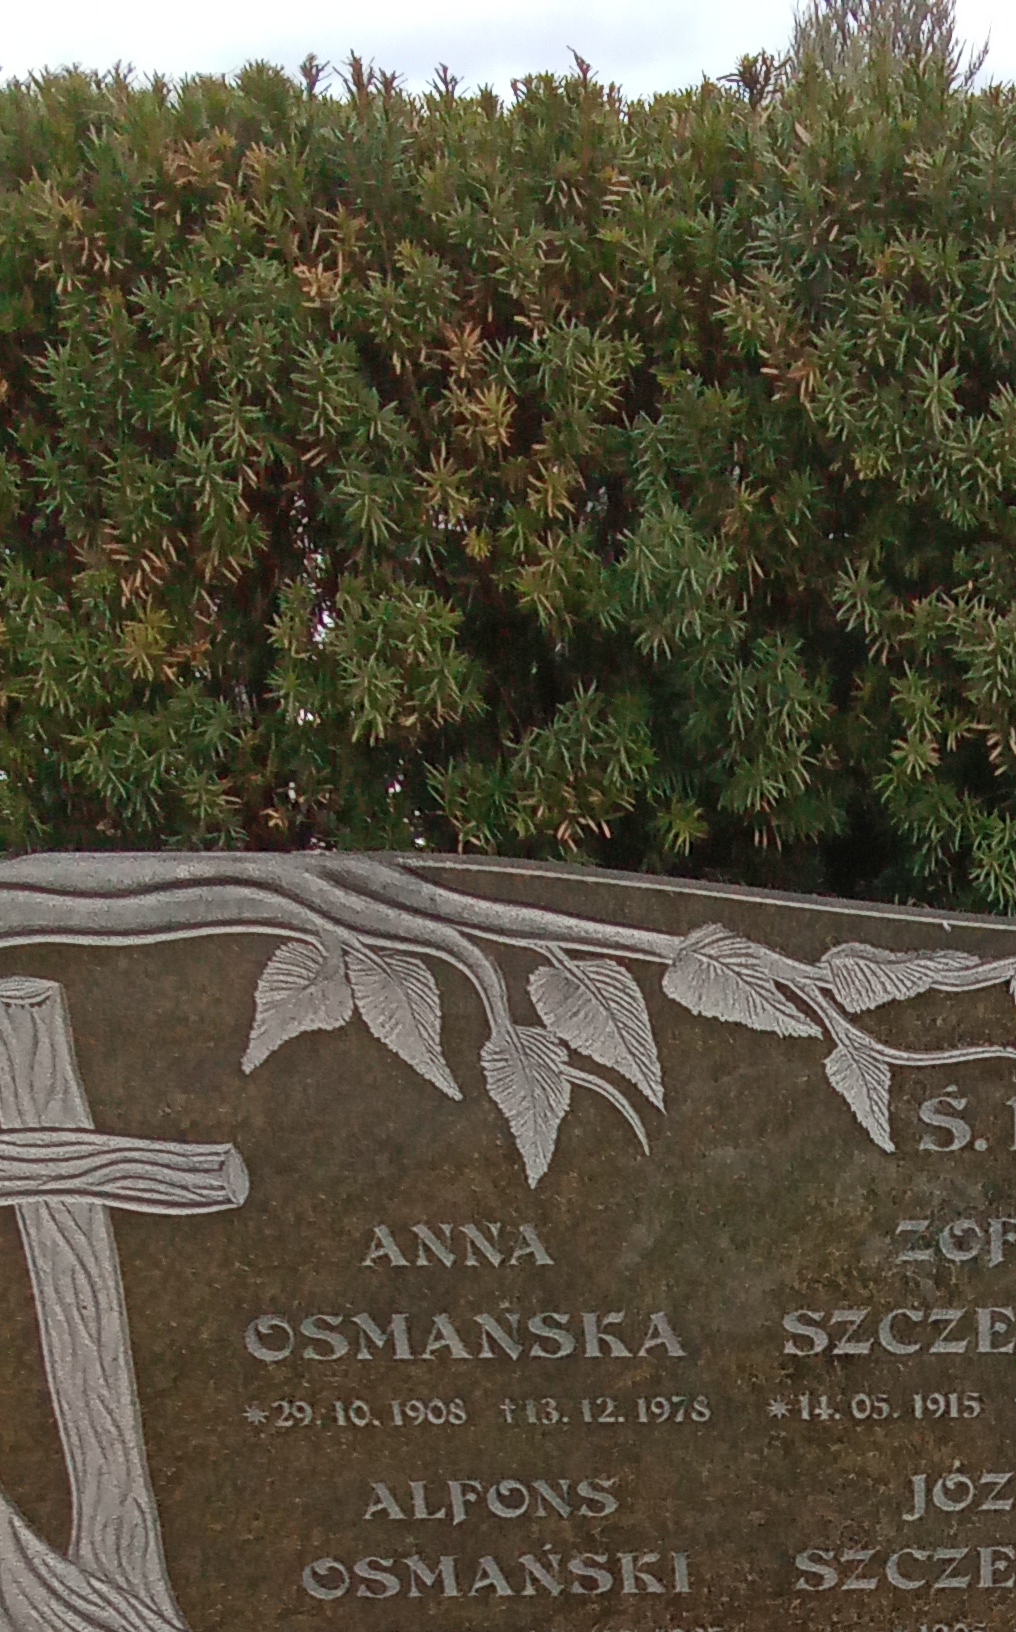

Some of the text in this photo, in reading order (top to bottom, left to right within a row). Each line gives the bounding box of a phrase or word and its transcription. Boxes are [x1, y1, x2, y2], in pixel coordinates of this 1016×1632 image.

[361, 1222, 555, 1268] ANNA
[363, 1478, 620, 1526] ALFONS
[302, 1544, 693, 1600] OSMAŃSKI
